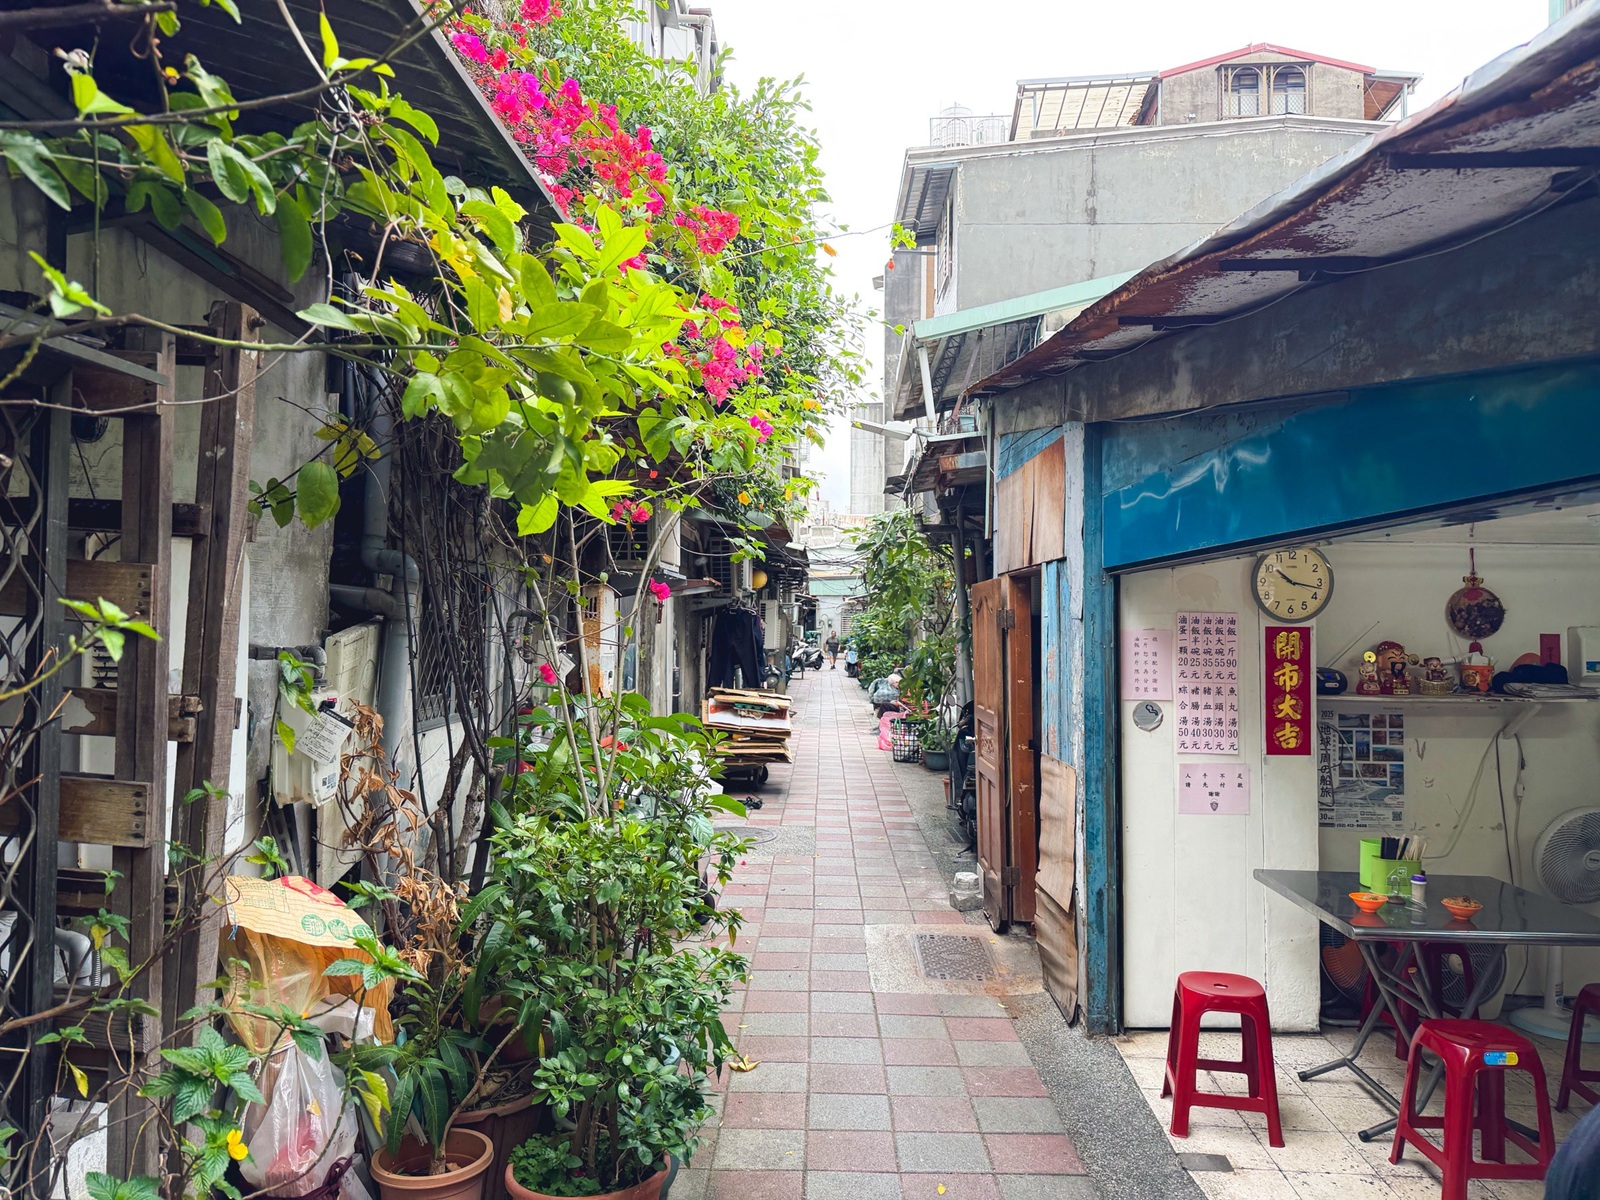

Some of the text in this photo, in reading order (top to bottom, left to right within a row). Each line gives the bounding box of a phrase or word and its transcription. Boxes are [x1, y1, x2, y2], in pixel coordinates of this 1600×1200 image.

[1275, 554, 1283, 563] 11
[1288, 550, 1297, 560] 12
[1303, 554, 1307, 564] 1
[1264, 564, 1274, 573] 10
[1312, 563, 1319, 573] 2
[1259, 578, 1267, 587] 9
[1316, 578, 1323, 587] 3
[1264, 591, 1270, 600] 8
[1311, 592, 1318, 601] 4
[1274, 601, 1280, 610] 7
[1287, 605, 1294, 614] 6
[1301, 601, 1307, 610] 5
[1273, 631, 1303, 749] 開市大吉
[1321, 710, 1334, 718] 2025
